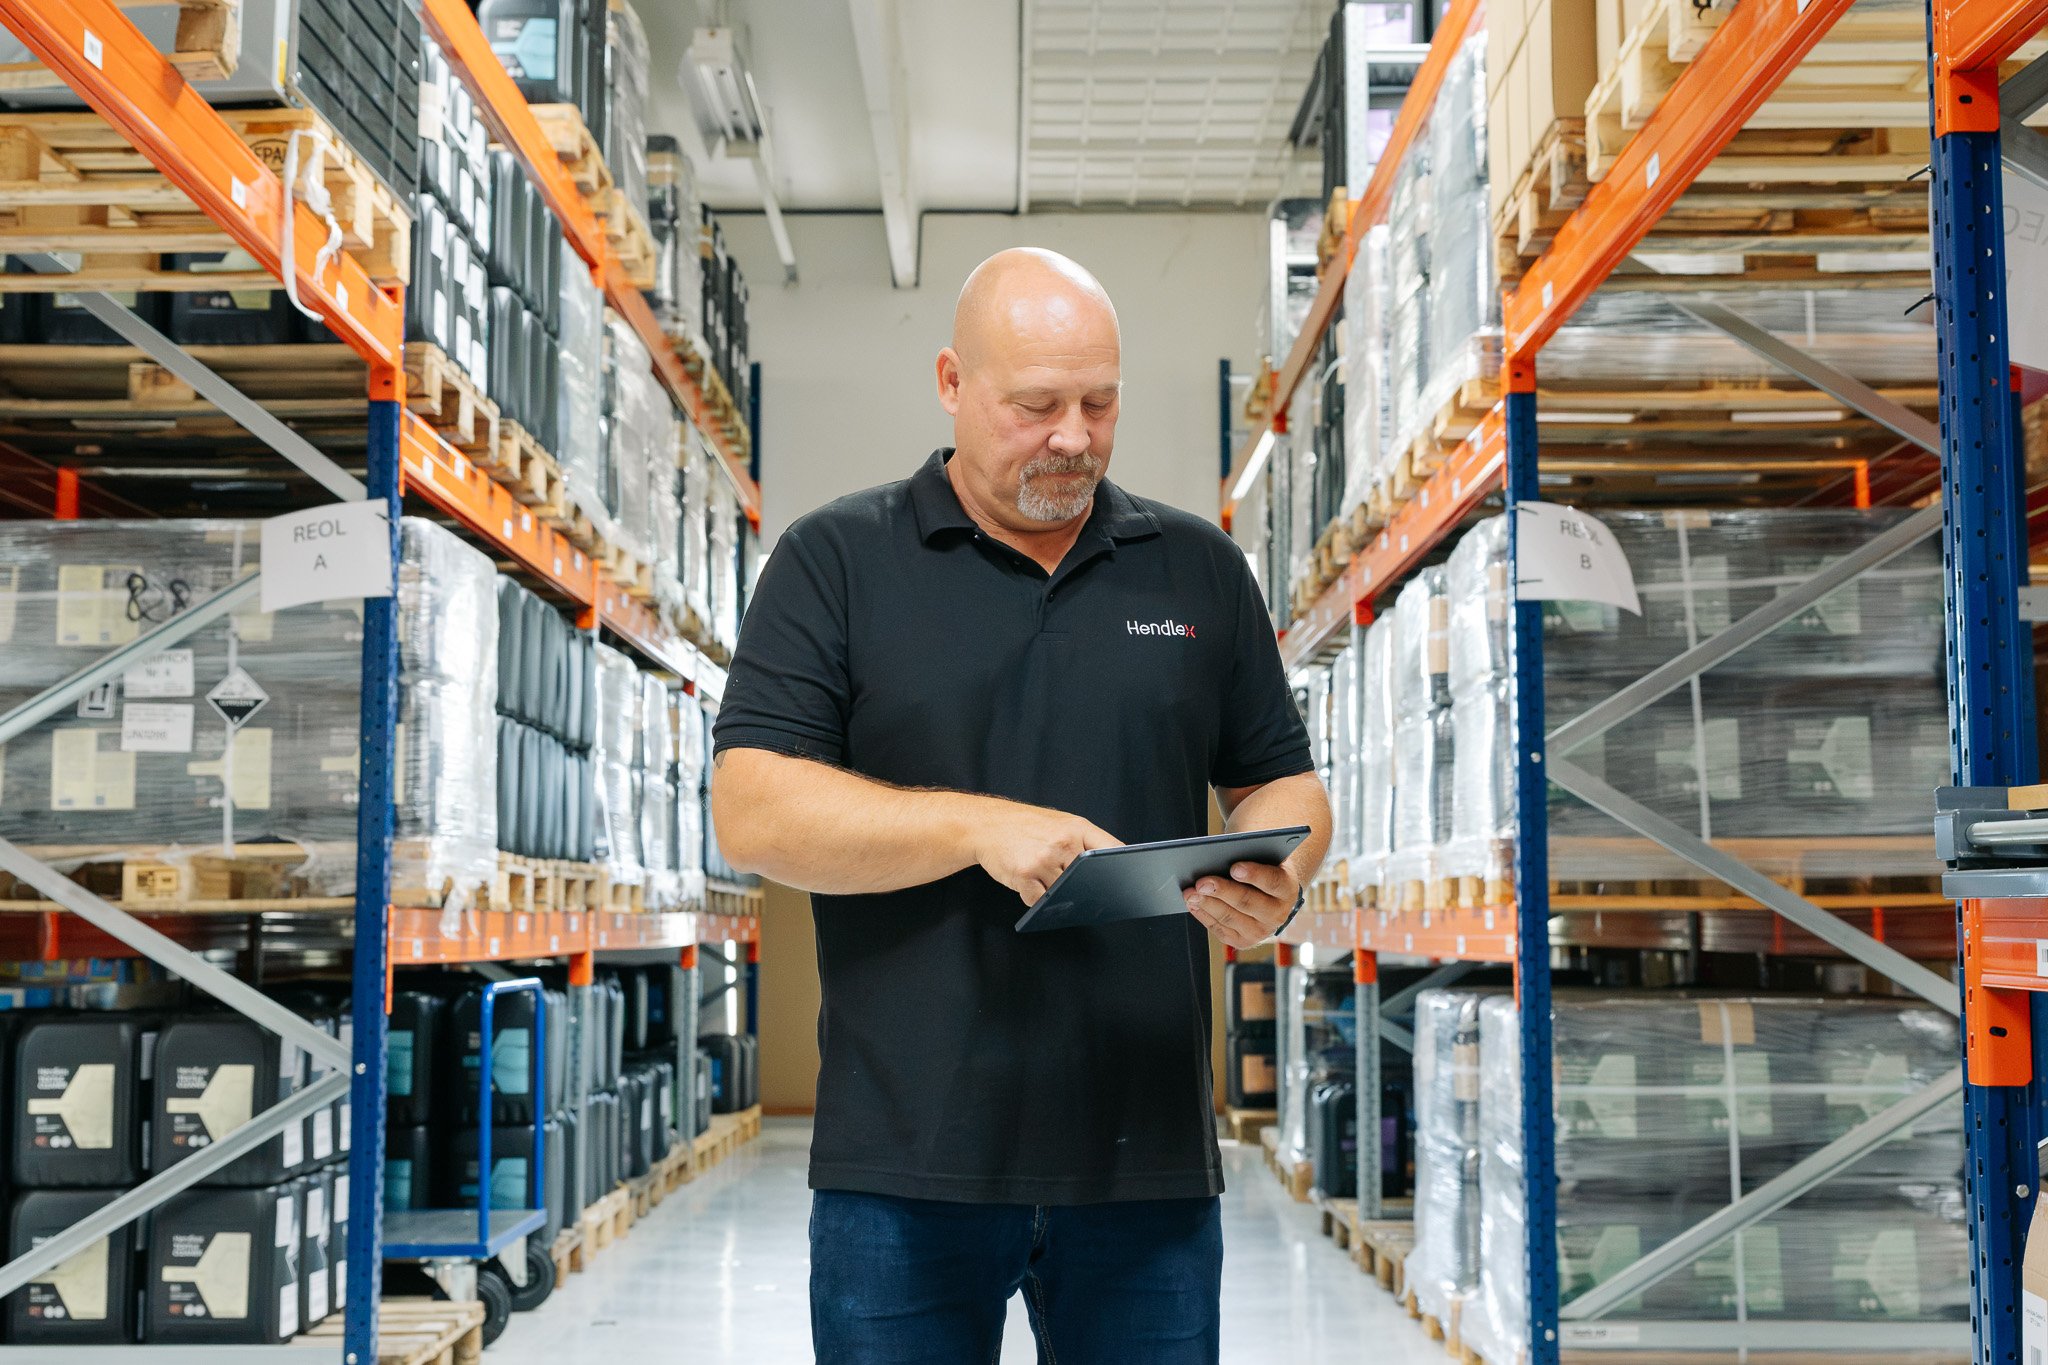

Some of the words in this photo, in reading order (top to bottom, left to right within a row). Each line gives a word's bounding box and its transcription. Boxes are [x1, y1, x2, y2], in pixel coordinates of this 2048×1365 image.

[293, 519, 347, 543] REOL
[313, 553, 328, 571] A
[1580, 553, 1592, 570] B
[1126, 619, 1196, 639] Hendlex
